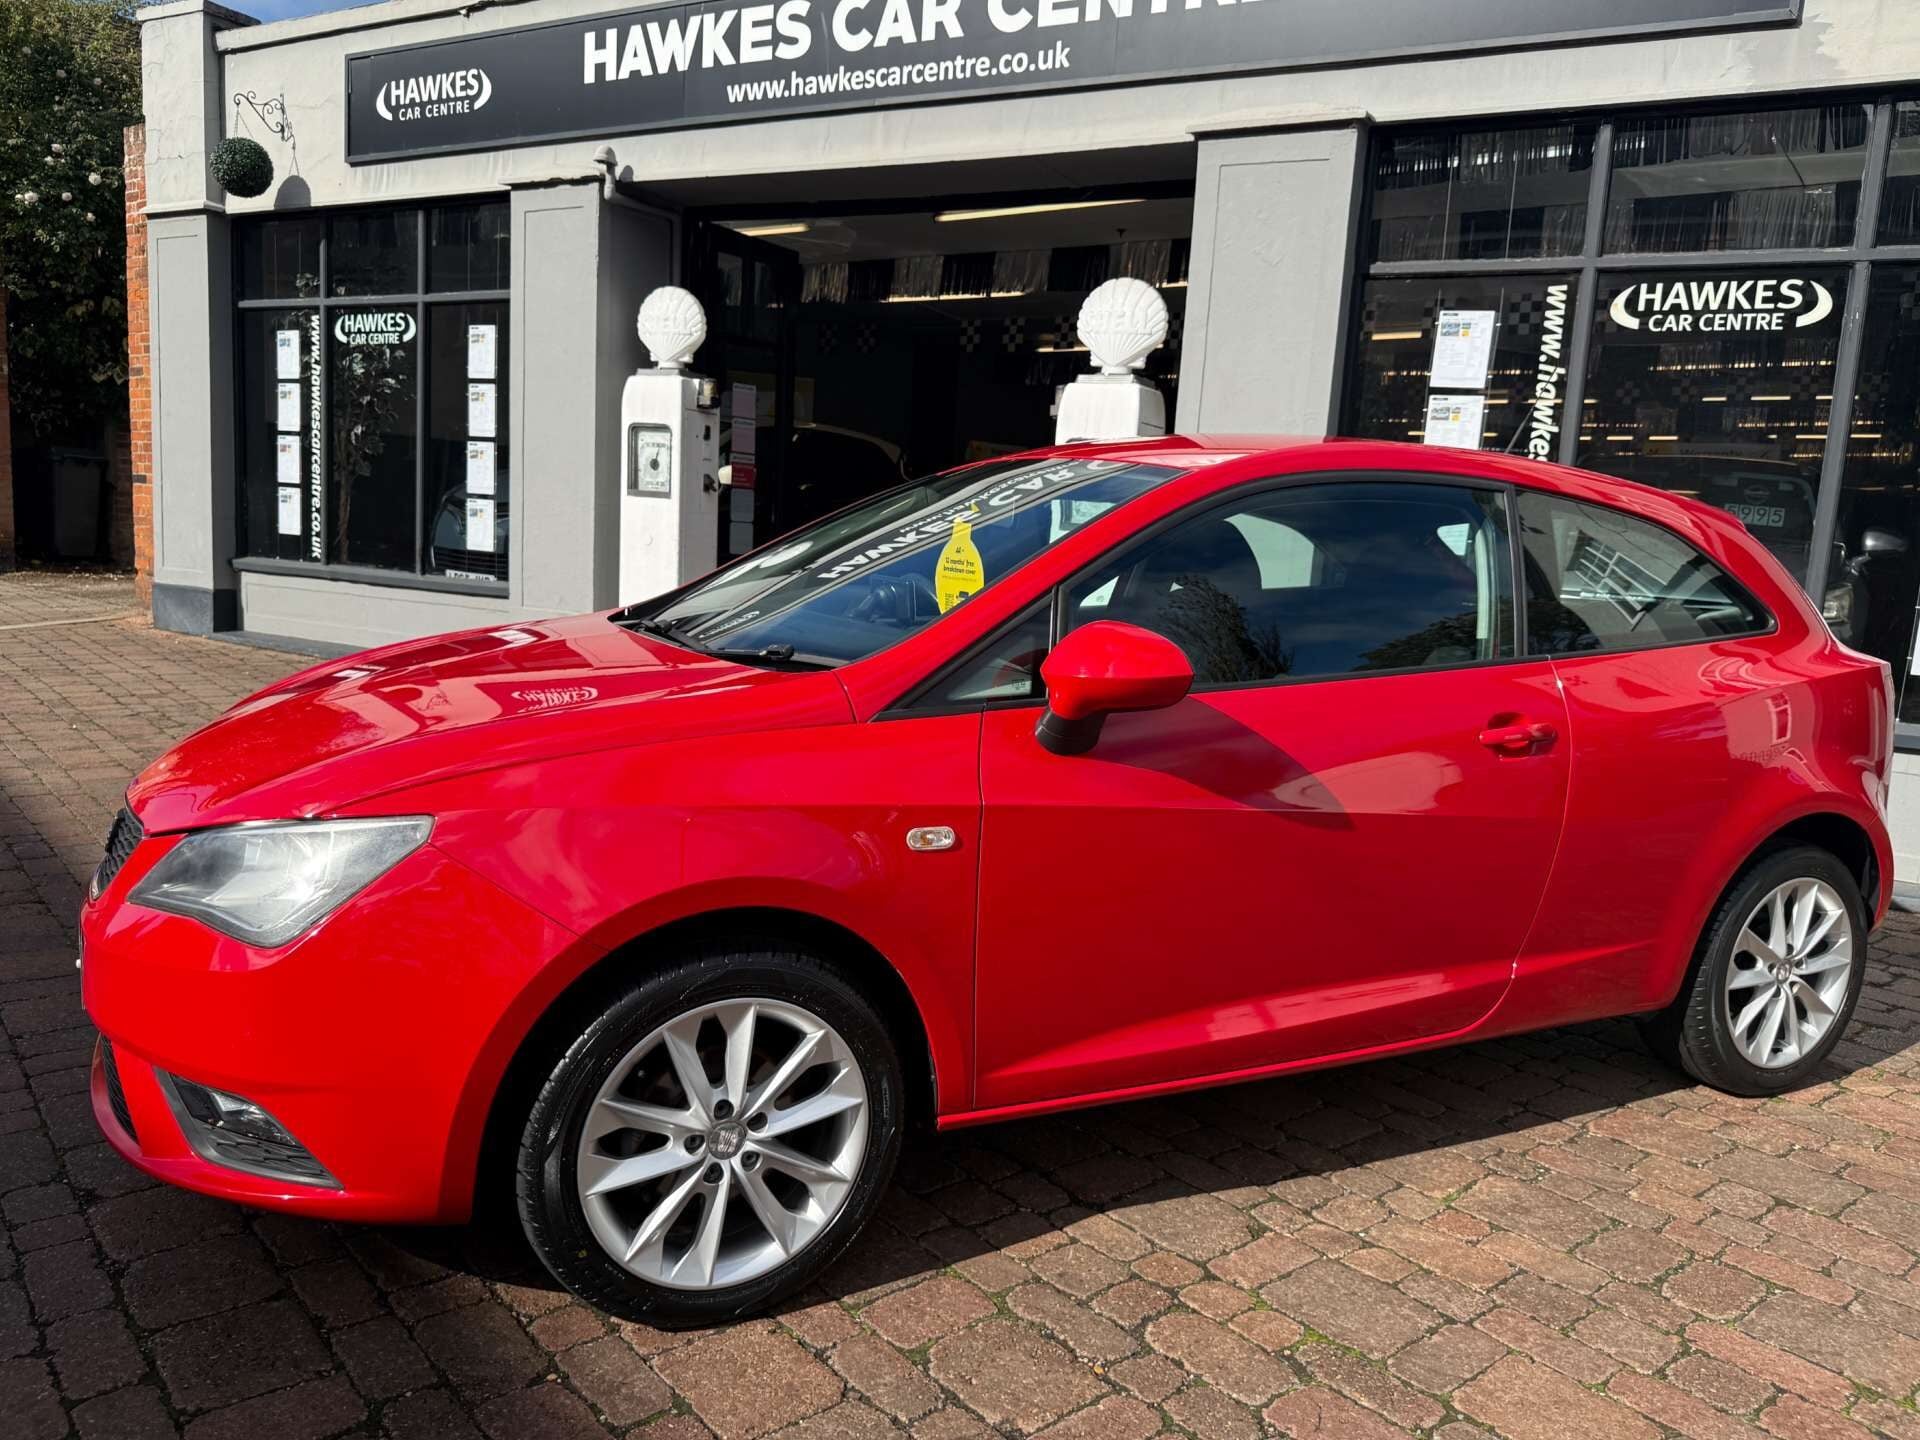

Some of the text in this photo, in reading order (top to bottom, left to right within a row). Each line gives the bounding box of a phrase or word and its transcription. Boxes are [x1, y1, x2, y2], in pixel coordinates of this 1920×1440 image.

[584, 0, 812, 84] HAWKES
[832, 0, 965, 51] CAR
[391, 68, 479, 106] HAWKES
[727, 41, 1070, 103] www.hawkescarcentre.co.uk
[399, 100, 470, 121] CAR CENTRE
[1637, 278, 1804, 312] HAWKES
[344, 312, 406, 332] HAWKES
[349, 332, 400, 345] CAR CENTRE
[1648, 312, 1785, 332] CAR CENTRE
[311, 315, 322, 559] www.hawkescarcentre.co.uk
